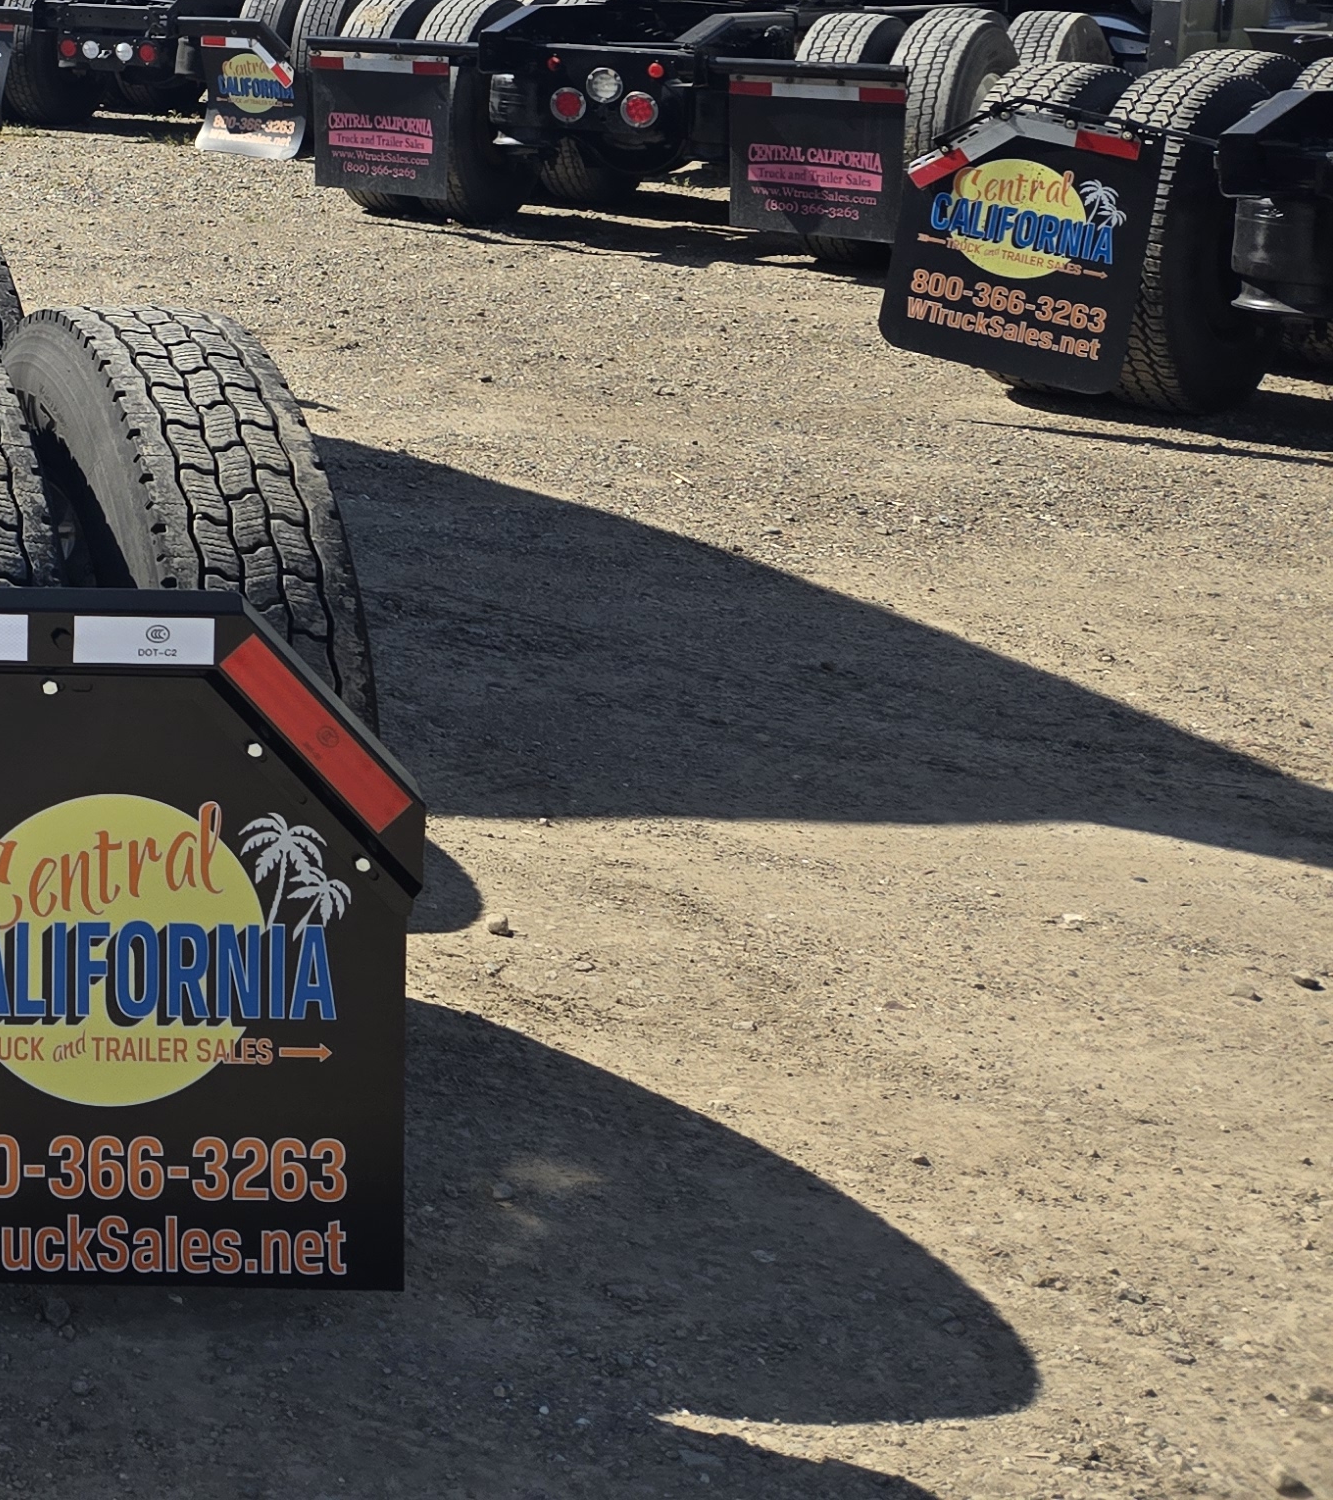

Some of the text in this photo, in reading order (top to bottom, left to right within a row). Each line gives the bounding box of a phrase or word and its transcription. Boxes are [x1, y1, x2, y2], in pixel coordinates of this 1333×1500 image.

[222, 60, 271, 77] Centra
[213, 114, 295, 135] 800-366-3263
[328, 112, 433, 137] CENTRAL CALIFORNIA
[336, 133, 425, 150] Truck and Trailer Sales
[342, 161, 416, 179] (800) 366-3263
[748, 143, 883, 173] CENTRAL CALIFORNIA
[757, 167, 872, 187] Truck and Trailer Sales
[952, 166, 1075, 208] Central
[764, 198, 860, 221] (800) 366-3263
[930, 191, 1113, 265] CALIFORNIA
[945, 237, 982, 256] TRUCK
[1001, 249, 1045, 268] TRAILER
[1046, 258, 1084, 276] SALES
[910, 267, 1108, 334] 800-366-3263
[906, 295, 1103, 361] WTruckSales.net
[137, 648, 178, 657] DOT-C2
[52, 1028, 88, 1063] and
[91, 1035, 189, 1063] TRAILER
[195, 1037, 274, 1065] SALES
